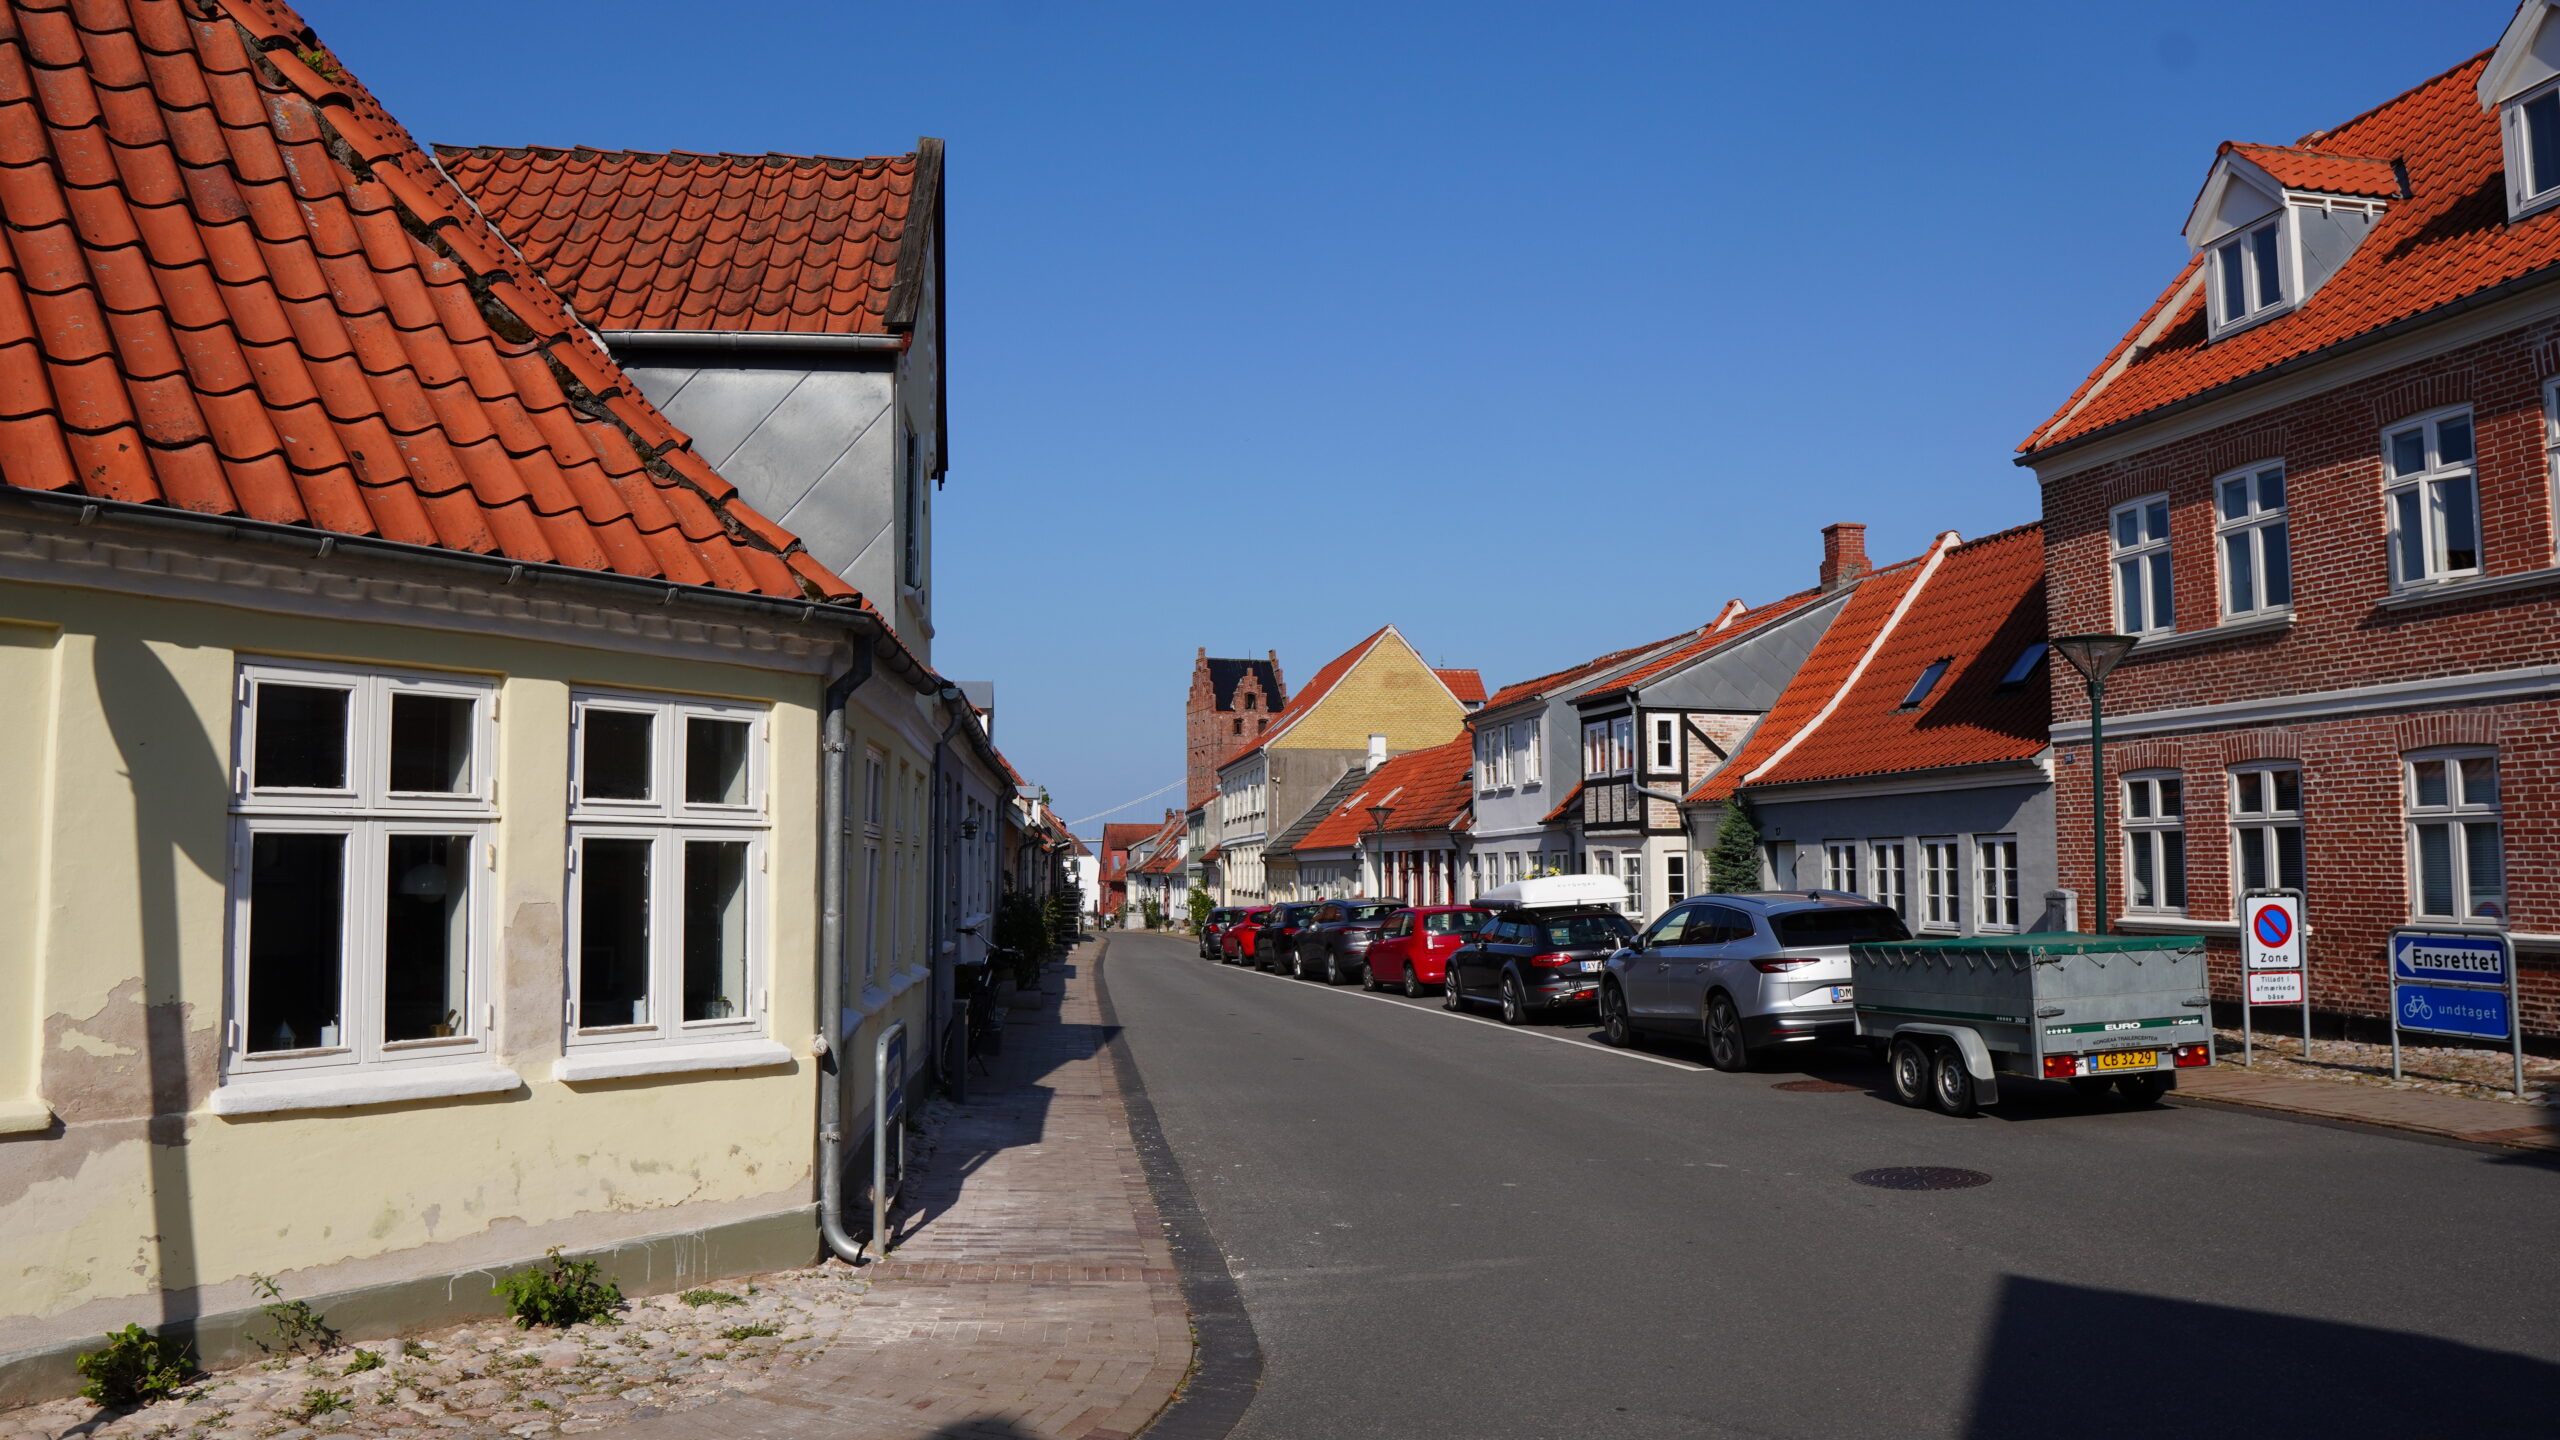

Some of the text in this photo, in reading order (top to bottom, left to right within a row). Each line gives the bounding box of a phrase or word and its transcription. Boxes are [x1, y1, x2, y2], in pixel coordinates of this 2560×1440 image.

[2260, 953, 2289, 963] Zone
[2412, 948, 2499, 972] Ensrettet
[1839, 988, 1852, 997] DM
[2439, 1004, 2497, 1020] undtaget
[2104, 1022, 2141, 1031] EURO
[2103, 1051, 2151, 1067] CB 32 29
